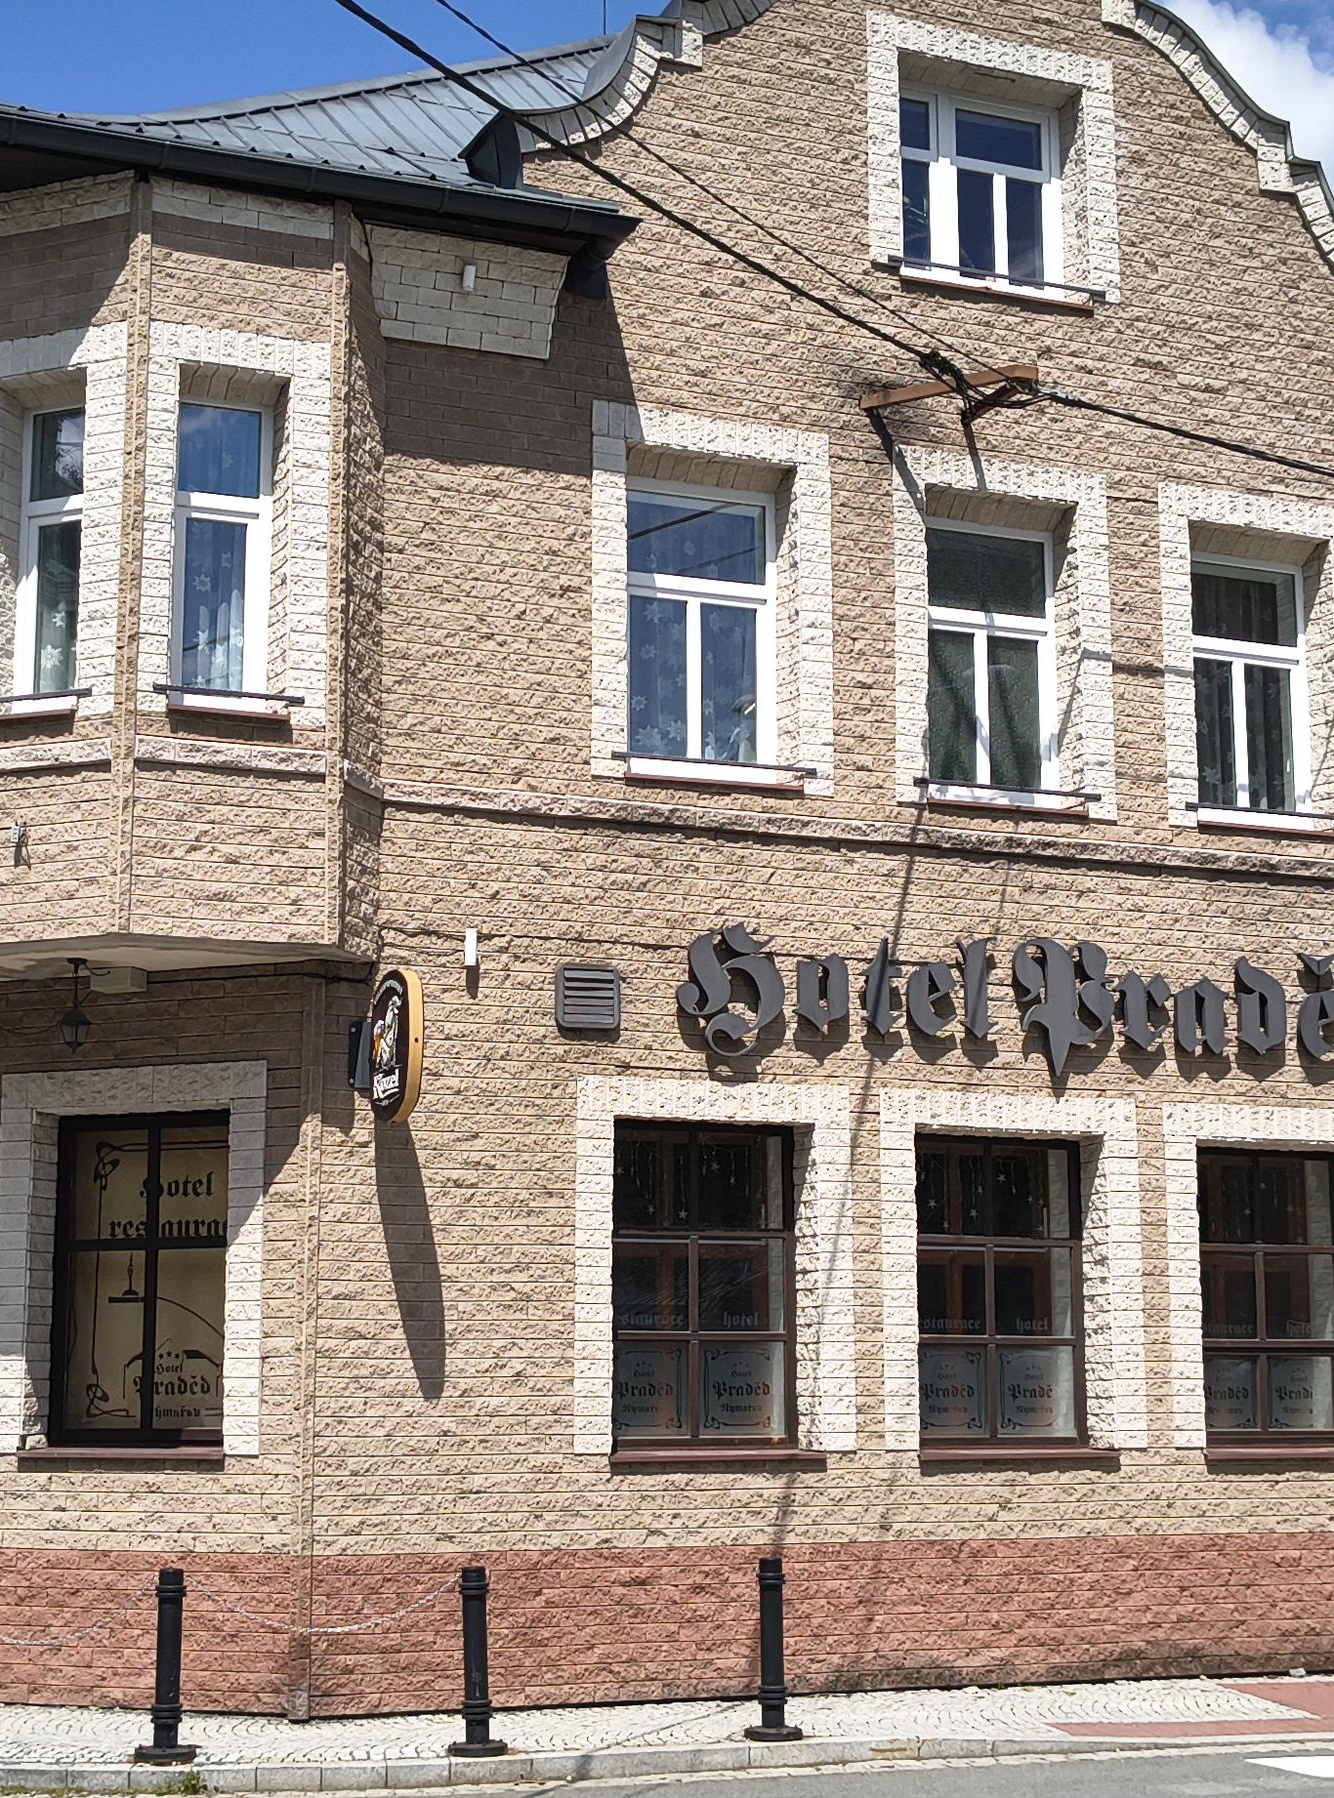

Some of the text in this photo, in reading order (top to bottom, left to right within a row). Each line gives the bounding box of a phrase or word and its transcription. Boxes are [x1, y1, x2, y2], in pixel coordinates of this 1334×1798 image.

[676, 921, 997, 1057] Hotel
[108, 1218, 227, 1238] resaura
[922, 1317, 982, 1330] staurace
[618, 1381, 674, 1399] Praděd
[712, 1381, 771, 1400] Praděd
[920, 1384, 975, 1401] Praděd
[1007, 1384, 1053, 1402] Pradě
[154, 1404, 201, 1419] ýmařov
